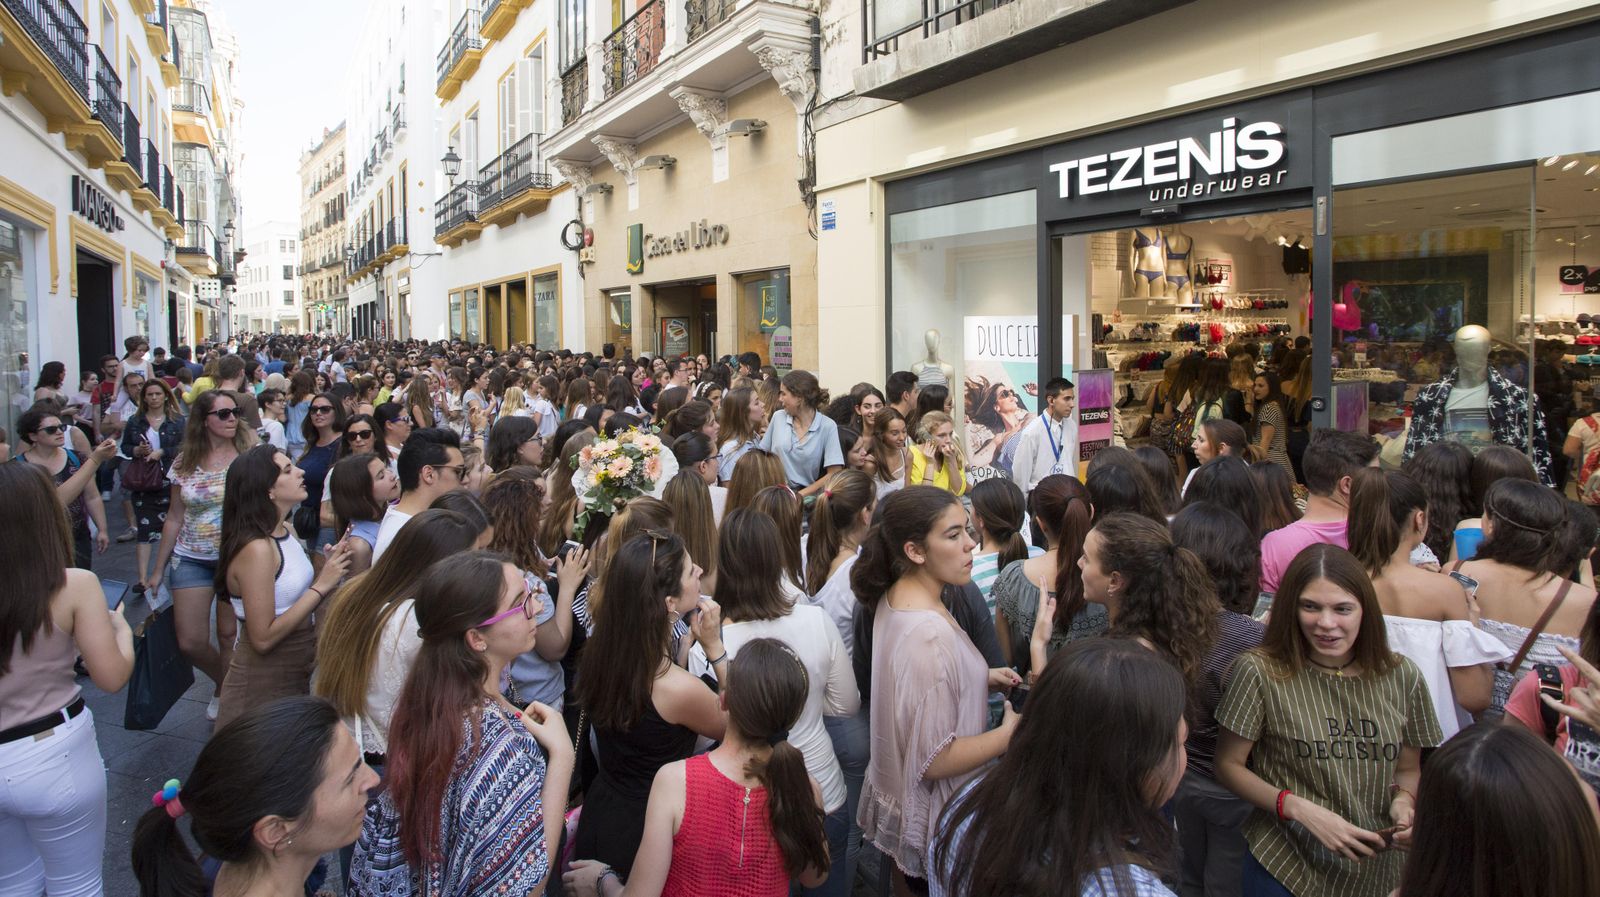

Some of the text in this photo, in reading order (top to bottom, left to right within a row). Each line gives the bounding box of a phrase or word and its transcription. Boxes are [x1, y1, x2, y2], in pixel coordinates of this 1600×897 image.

[1149, 169, 1287, 202] underwear
[72, 175, 115, 232] MANGO
[644, 219, 730, 258] Casa del Libro
[1563, 268, 1583, 280] 2x
[537, 290, 555, 302] ZARA
[971, 465, 1007, 480] COPAS
[1325, 717, 1378, 738] BAD
